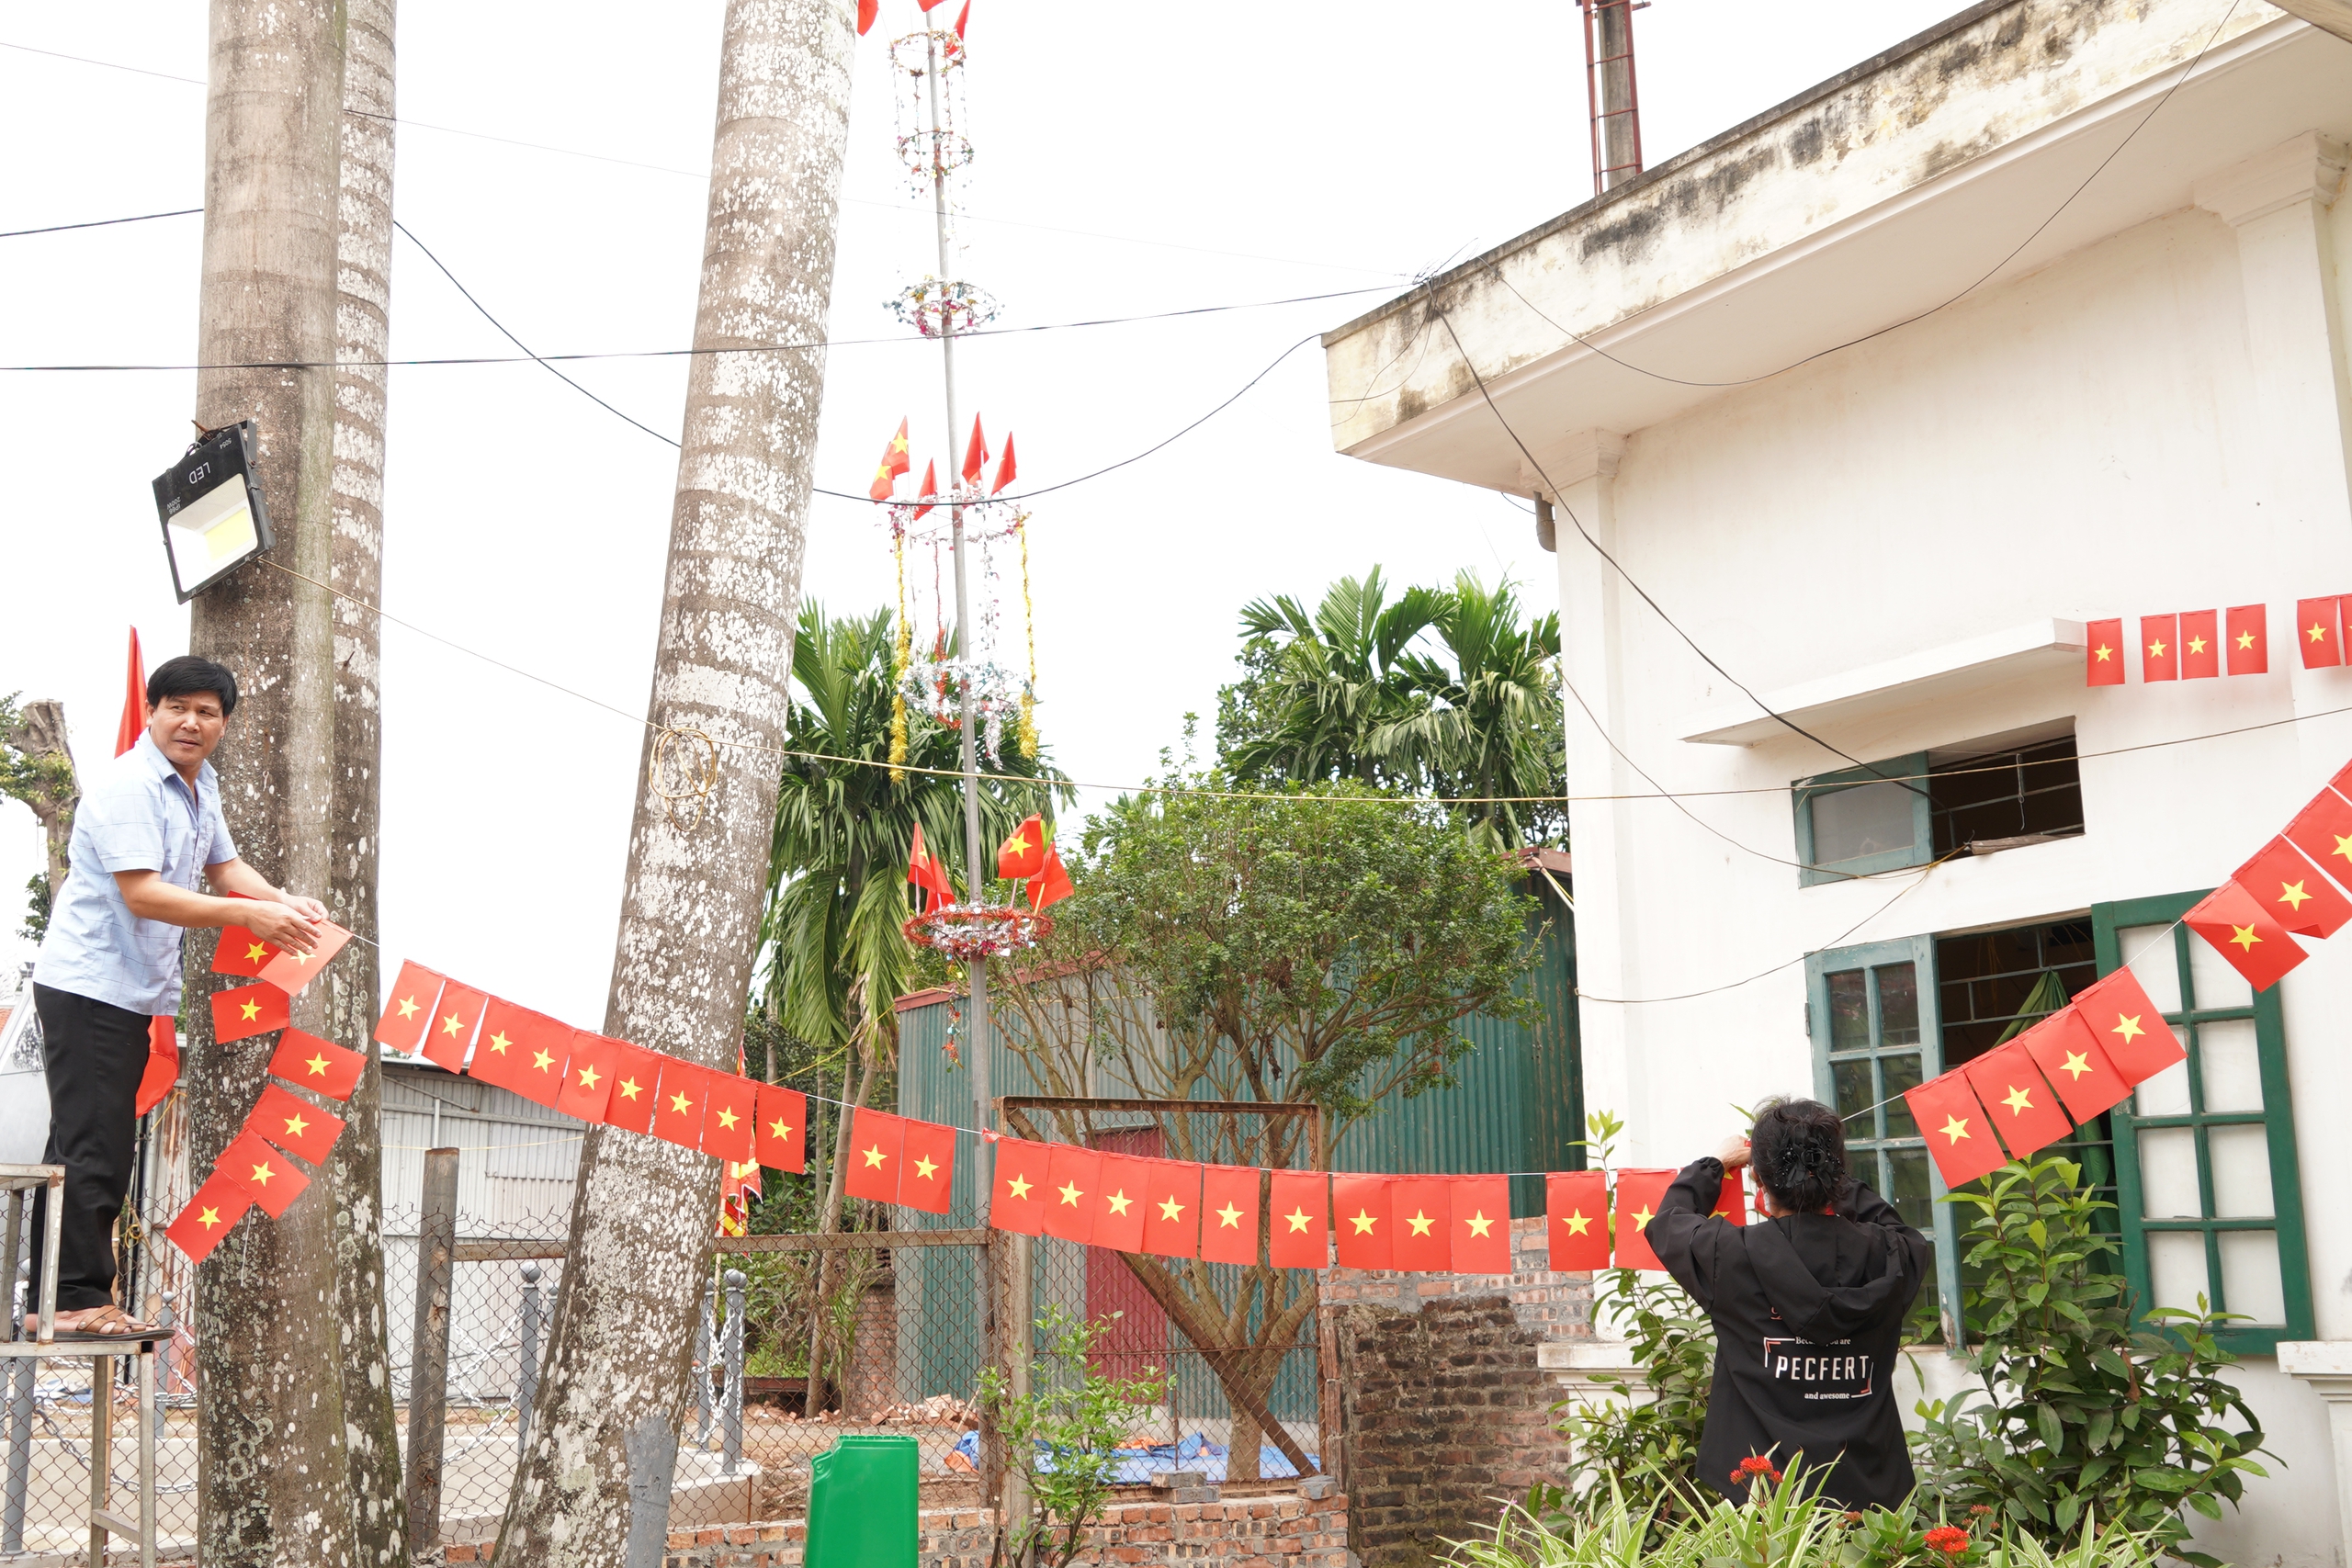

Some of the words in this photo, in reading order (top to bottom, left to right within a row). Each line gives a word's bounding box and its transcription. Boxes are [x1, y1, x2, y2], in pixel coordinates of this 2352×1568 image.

[189, 461, 210, 484] LED
[1775, 1355, 1870, 1381] PECFERT
[1804, 1392, 1819, 1400] and
